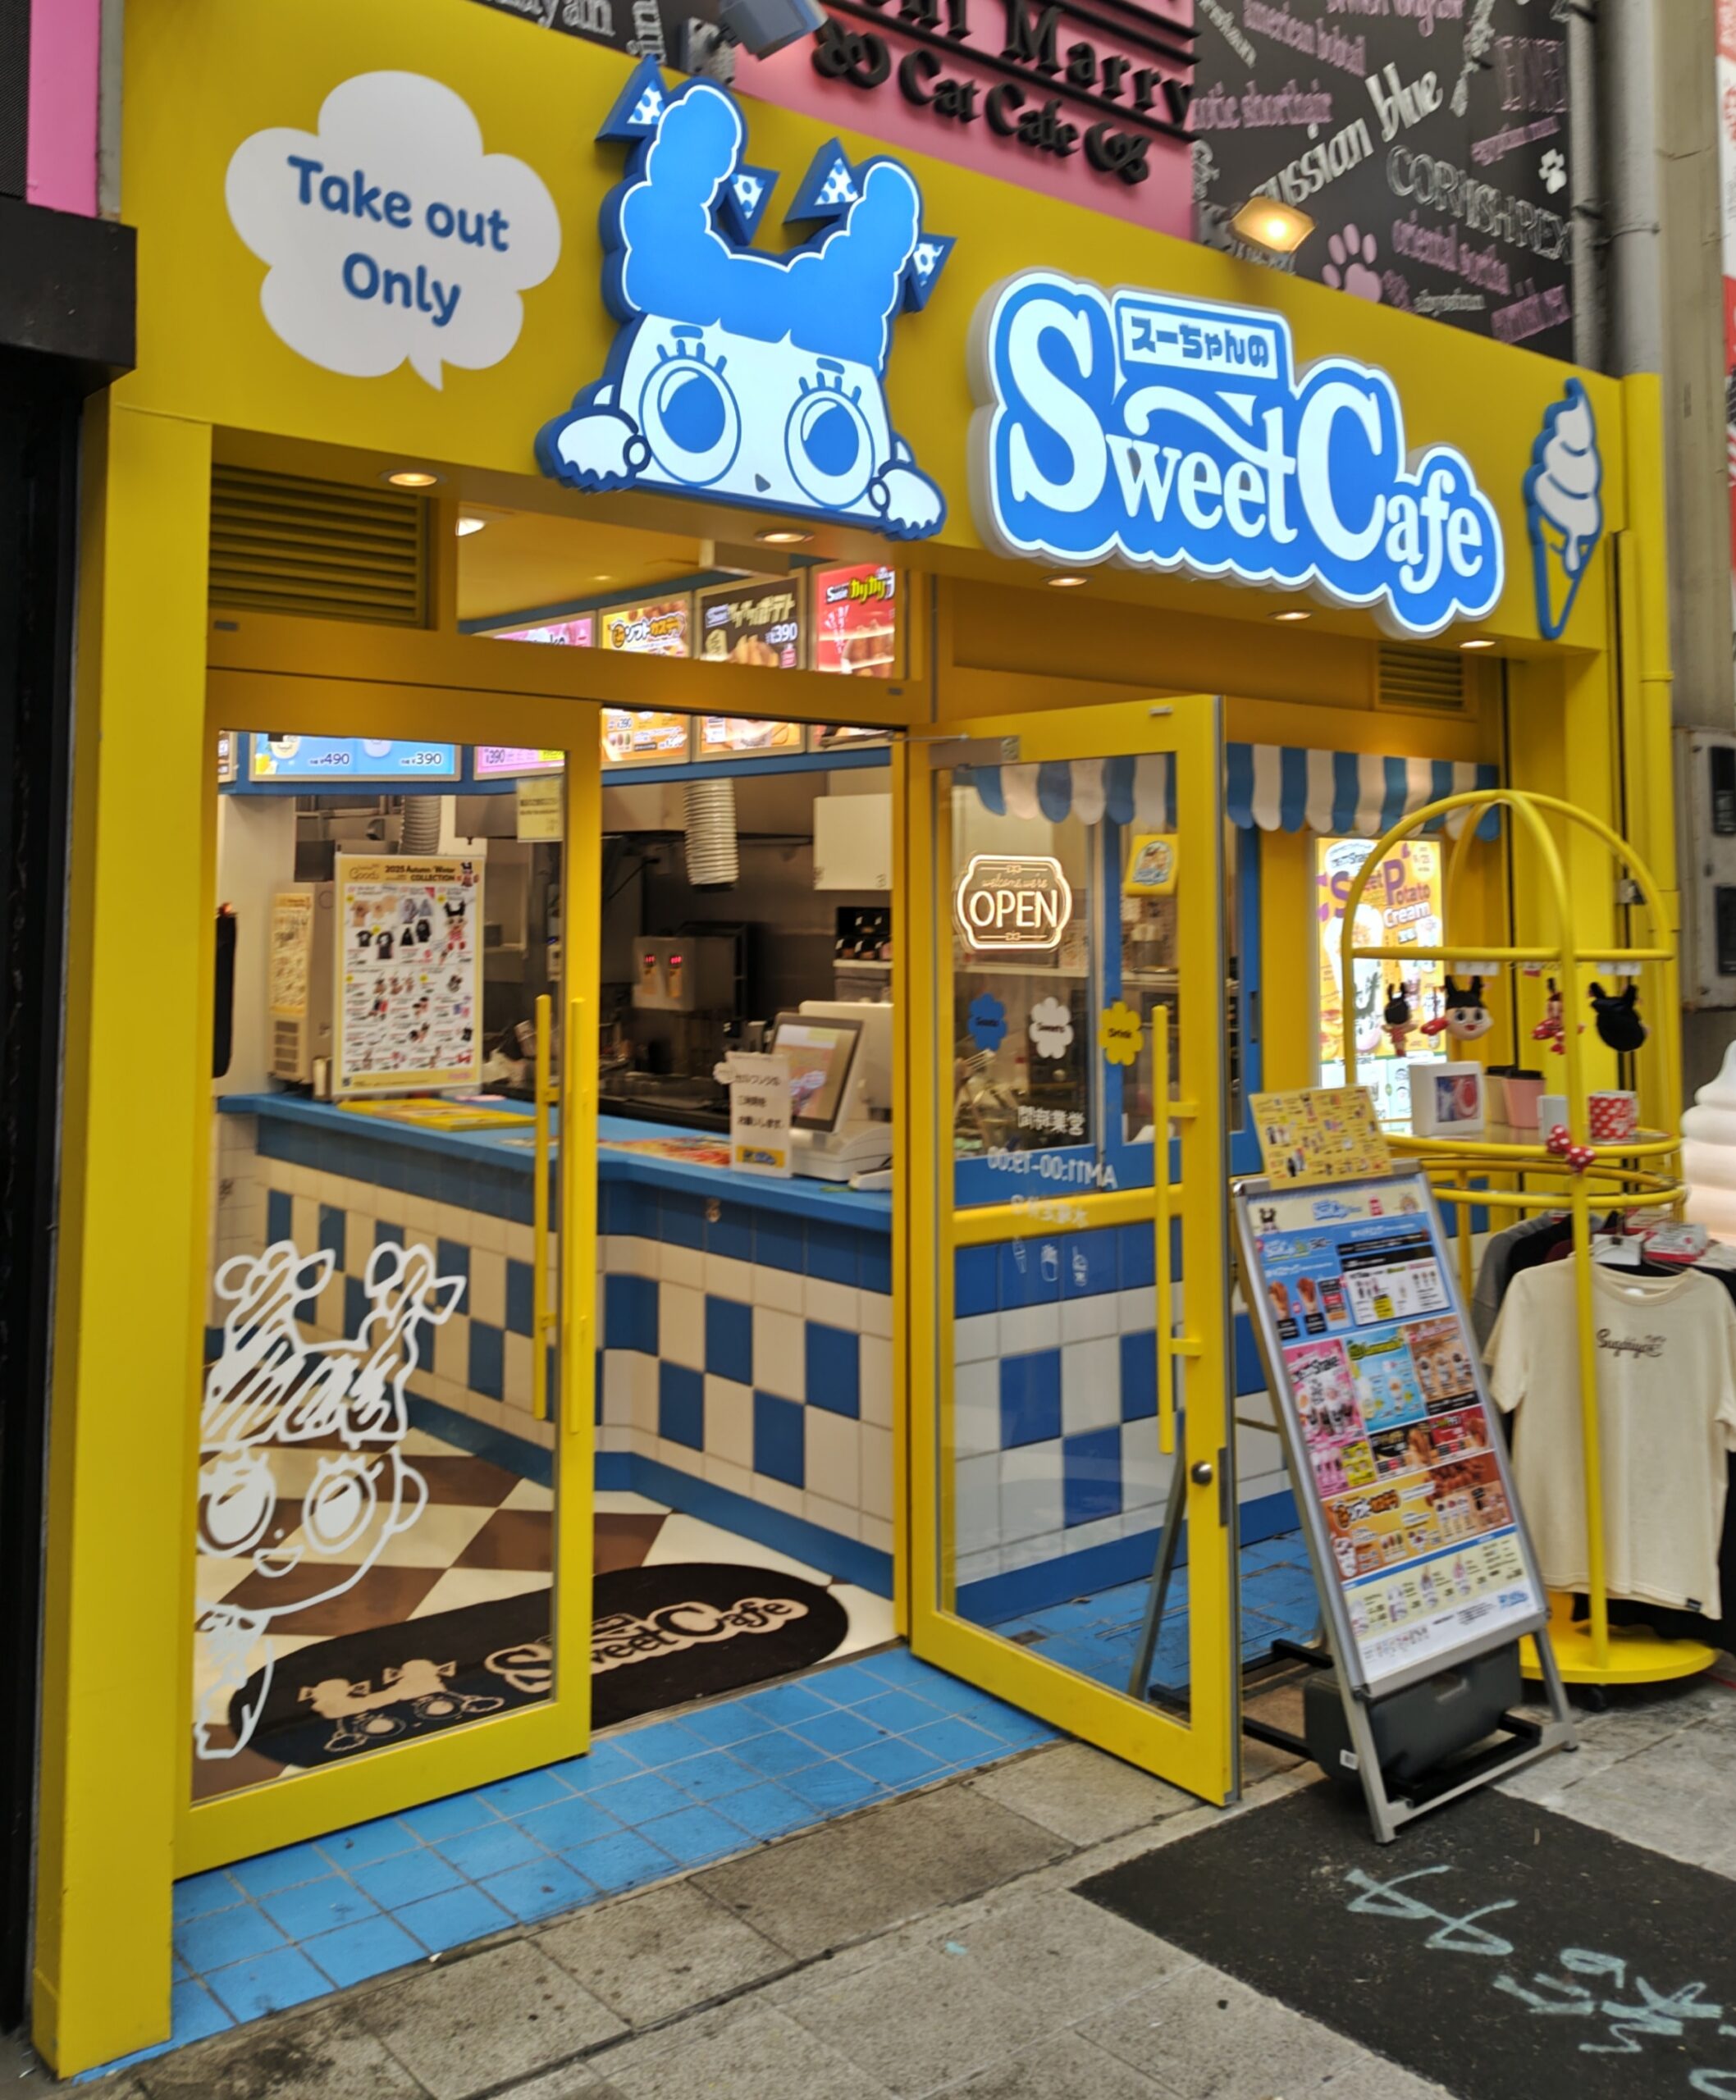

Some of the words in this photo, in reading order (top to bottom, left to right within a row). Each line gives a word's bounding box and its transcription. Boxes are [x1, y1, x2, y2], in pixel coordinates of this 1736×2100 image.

[898, 48, 981, 123] Cat
[984, 82, 1080, 158] Cafe
[1000, 2, 1194, 127] Marry
[1249, 117, 1375, 206] ussian
[1364, 62, 1444, 143] blue
[286, 153, 412, 230] Take
[425, 201, 509, 253] out
[342, 252, 462, 327] Only
[1131, 315, 1271, 368] スーちゃんの
[1007, 298, 1297, 544] Sweet
[1297, 381, 1482, 595] Cafe
[969, 888, 1058, 929] OPEN
[1383, 902, 1432, 929] Cream
